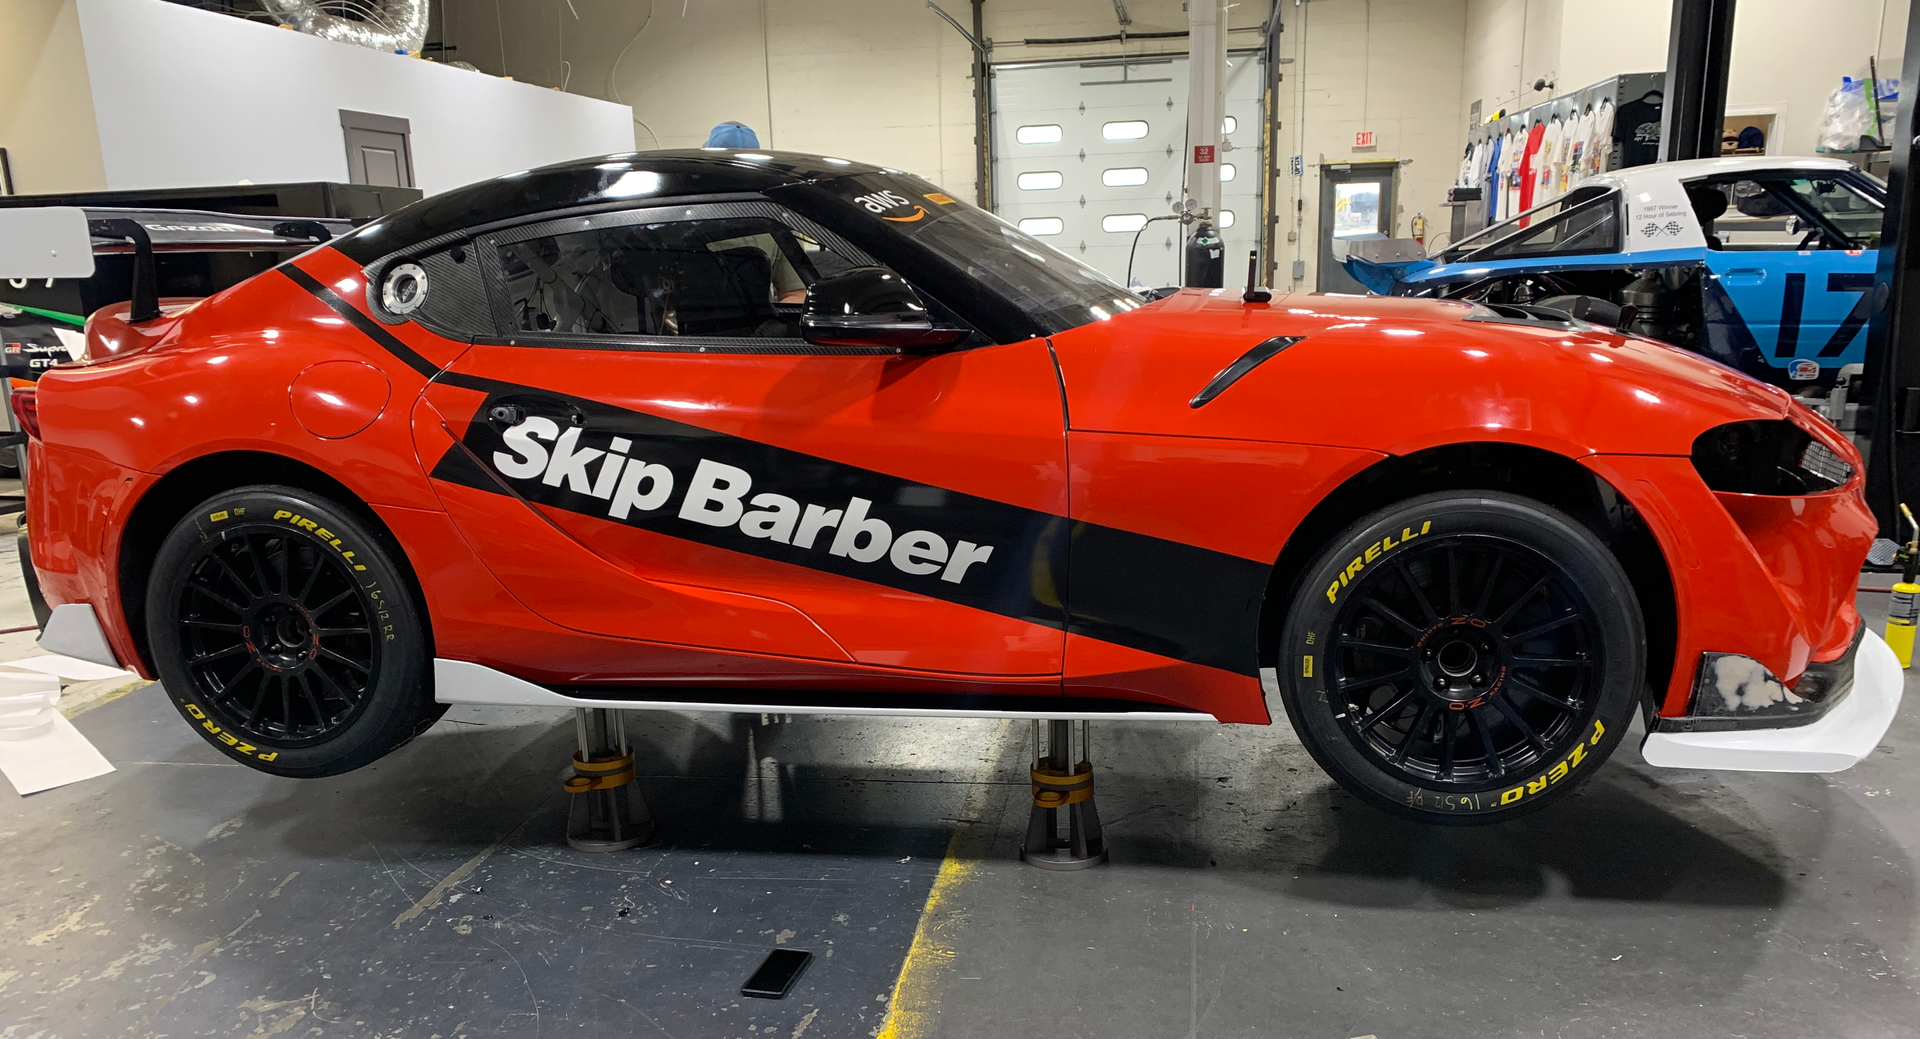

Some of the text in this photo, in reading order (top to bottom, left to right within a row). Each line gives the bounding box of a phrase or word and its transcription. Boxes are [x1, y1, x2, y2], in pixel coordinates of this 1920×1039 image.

[1200, 147, 1209, 155] 32
[1356, 131, 1373, 146] EXIT
[854, 190, 910, 214] aws
[1775, 273, 1876, 357] 17
[29, 358, 58, 368] GT4
[493, 416, 994, 583] Skip Barber
[273, 510, 367, 571] PIRELLI
[1326, 521, 1431, 604] PIRELLI
